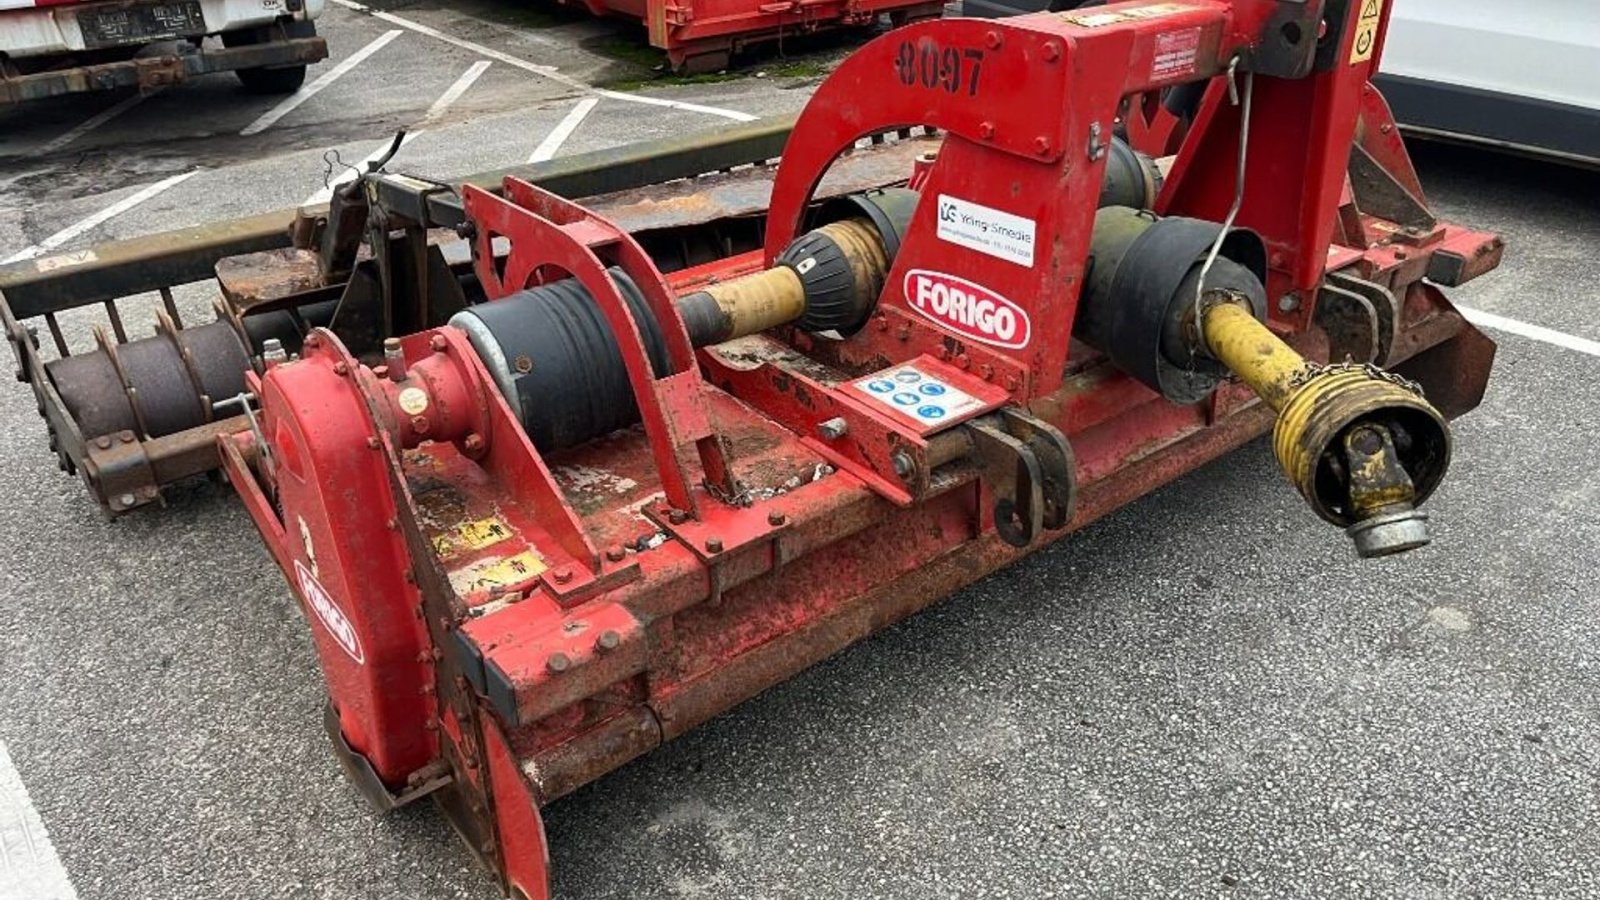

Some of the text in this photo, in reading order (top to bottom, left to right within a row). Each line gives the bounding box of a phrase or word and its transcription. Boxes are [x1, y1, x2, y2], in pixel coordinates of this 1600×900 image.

[899, 41, 985, 97] 8097
[916, 275, 1016, 341] FORIGO
[299, 566, 356, 653] FORIGO
